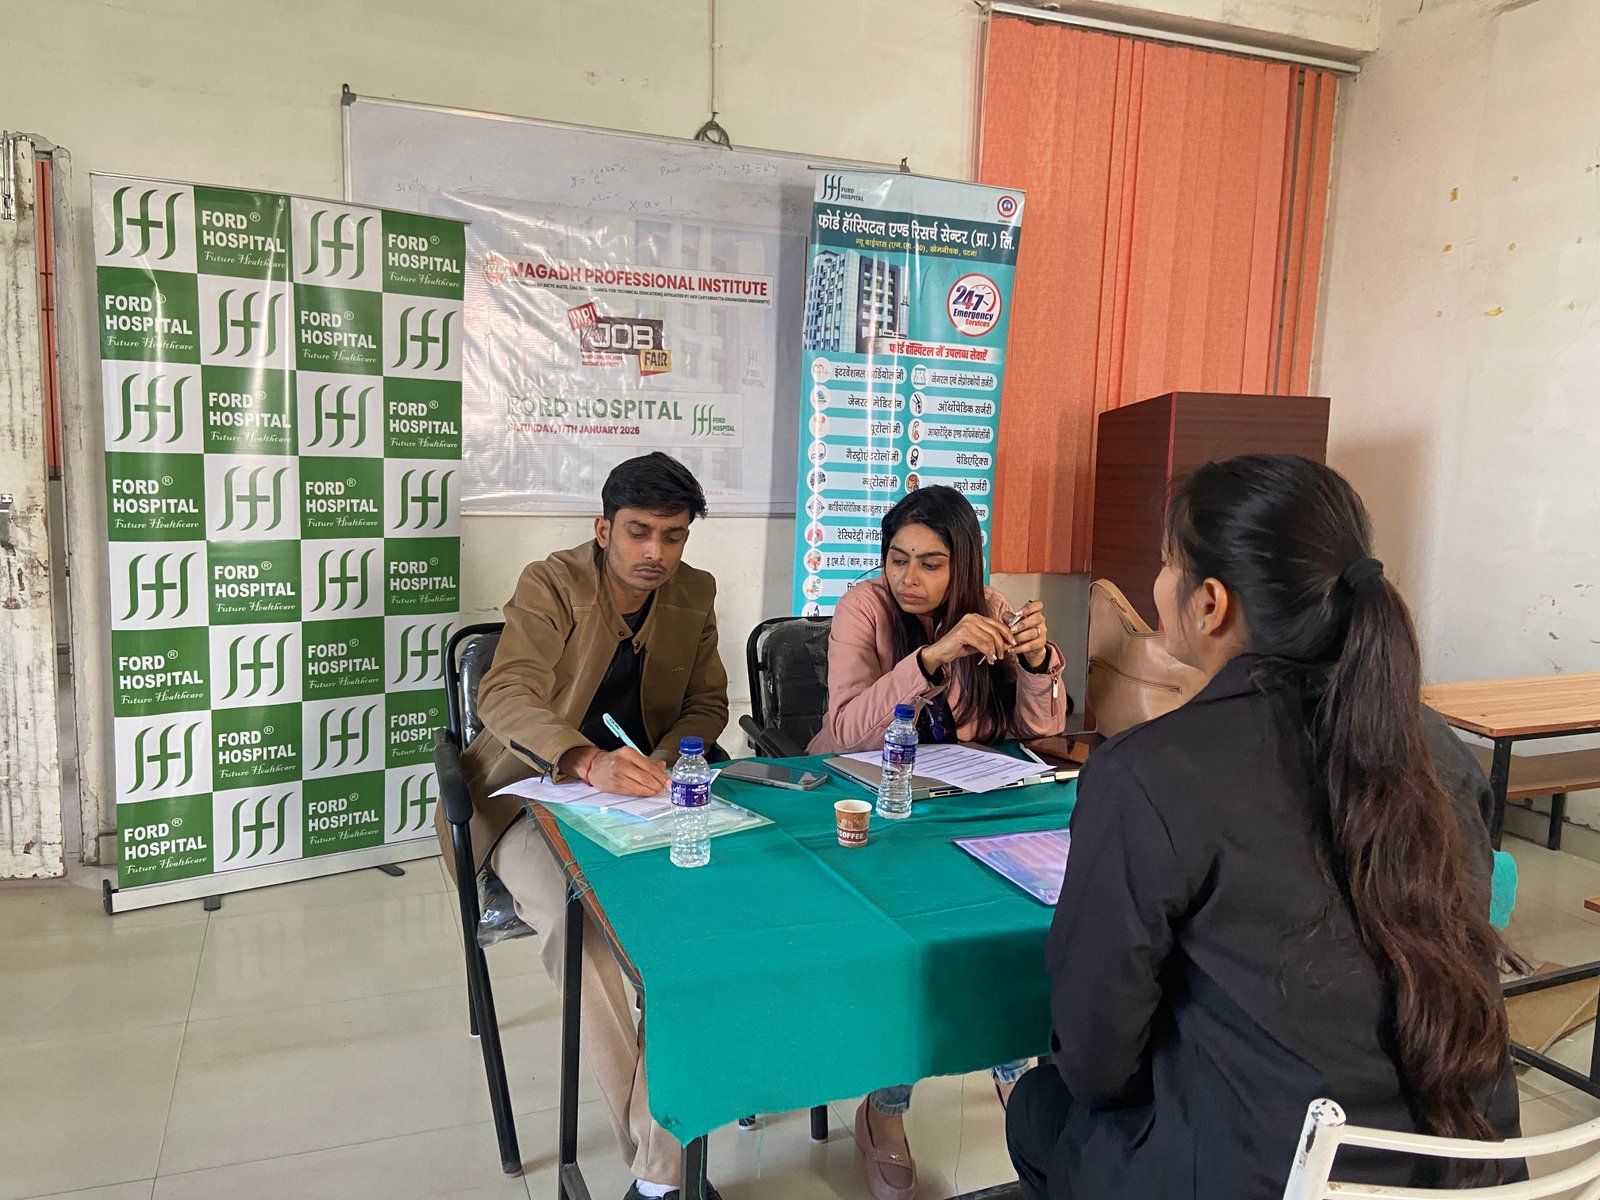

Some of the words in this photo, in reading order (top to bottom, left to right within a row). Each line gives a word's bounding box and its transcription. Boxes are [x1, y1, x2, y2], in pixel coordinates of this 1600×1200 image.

[840, 194, 865, 202] HOSPITAL
[201, 210, 248, 230] FORD
[818, 209, 840, 230] फोर्ड
[842, 212, 886, 236] हॉस्पिटल
[888, 223, 910, 237] एण्ड
[911, 219, 938, 241] रिसर्च
[940, 223, 968, 245] सेन्टर
[1000, 230, 1015, 250] लि.
[202, 230, 286, 253] HOSPITAL
[388, 234, 428, 252] FORD
[204, 251, 236, 265] Future
[388, 253, 460, 274] HOSPITAL
[388, 271, 417, 283] Future
[420, 274, 460, 288] Healthcare
[509, 262, 580, 281] MAGADH
[585, 268, 695, 291] PROFESSIONAL
[699, 276, 767, 296] INSTITUTE
[104, 294, 152, 313] FORD
[300, 310, 342, 328] FORD
[569, 304, 596, 326] MPI
[953, 308, 994, 321] Emergency
[105, 315, 192, 335] HOSPITAL
[965, 319, 990, 328] Services
[107, 335, 139, 349] Future
[301, 329, 376, 349] HOSPITAL
[590, 323, 654, 350] JOB
[302, 349, 330, 360] Future
[333, 351, 377, 364] Healthcare
[644, 351, 668, 367] FAIR
[208, 392, 253, 407] FORD
[389, 402, 428, 416] FORD
[507, 395, 568, 417] FORD
[576, 397, 683, 421] HOSPITAL
[209, 411, 291, 429] HOSPITAL
[389, 420, 458, 435] HOSPITAL
[211, 430, 242, 442] Future
[579, 425, 618, 435] JANUARY
[620, 426, 640, 435] 2026
[390, 437, 417, 448] Future
[418, 437, 458, 449] Healthcare
[112, 479, 159, 495] FORD
[305, 481, 345, 496] FORD
[113, 498, 199, 514] HOSPITAL
[306, 499, 378, 513] HOSPITAL
[114, 518, 147, 530] Future
[150, 517, 199, 530] Healthcare
[307, 518, 334, 528] Future
[336, 517, 378, 527] Healthcare
[214, 564, 259, 580] FORD
[390, 561, 428, 574] FORD
[214, 582, 295, 598] HOSPITAL
[390, 577, 456, 591] HOSPITAL
[216, 602, 247, 613] Future
[249, 601, 296, 612] Healthcare
[391, 595, 416, 605] Future
[418, 593, 456, 604] Healthcare
[308, 644, 347, 658] FORD
[119, 655, 165, 671] FORD
[308, 658, 379, 675] HOSPITAL
[119, 671, 203, 690] HOSPITAL
[309, 678, 336, 689] Future
[338, 676, 380, 686] Healthcare
[121, 693, 153, 706] Future
[155, 690, 204, 702] Healthcare
[390, 713, 427, 727] FORD
[218, 731, 261, 747] FORD
[391, 726, 447, 744] HOSPI
[218, 744, 296, 765] HOSPITAL
[392, 746, 416, 757] Future
[220, 767, 249, 779] Future
[251, 764, 296, 776] Healthcare
[308, 799, 347, 815] FORD
[308, 811, 379, 832] HOSPITAL
[124, 824, 170, 842] FORD
[309, 834, 336, 845] Future
[338, 829, 379, 840] Healthcare
[840, 830, 864, 840] COFFEE
[124, 836, 206, 860] HOSPITAL
[126, 862, 158, 874] Future
[160, 856, 207, 869] Healthcare
